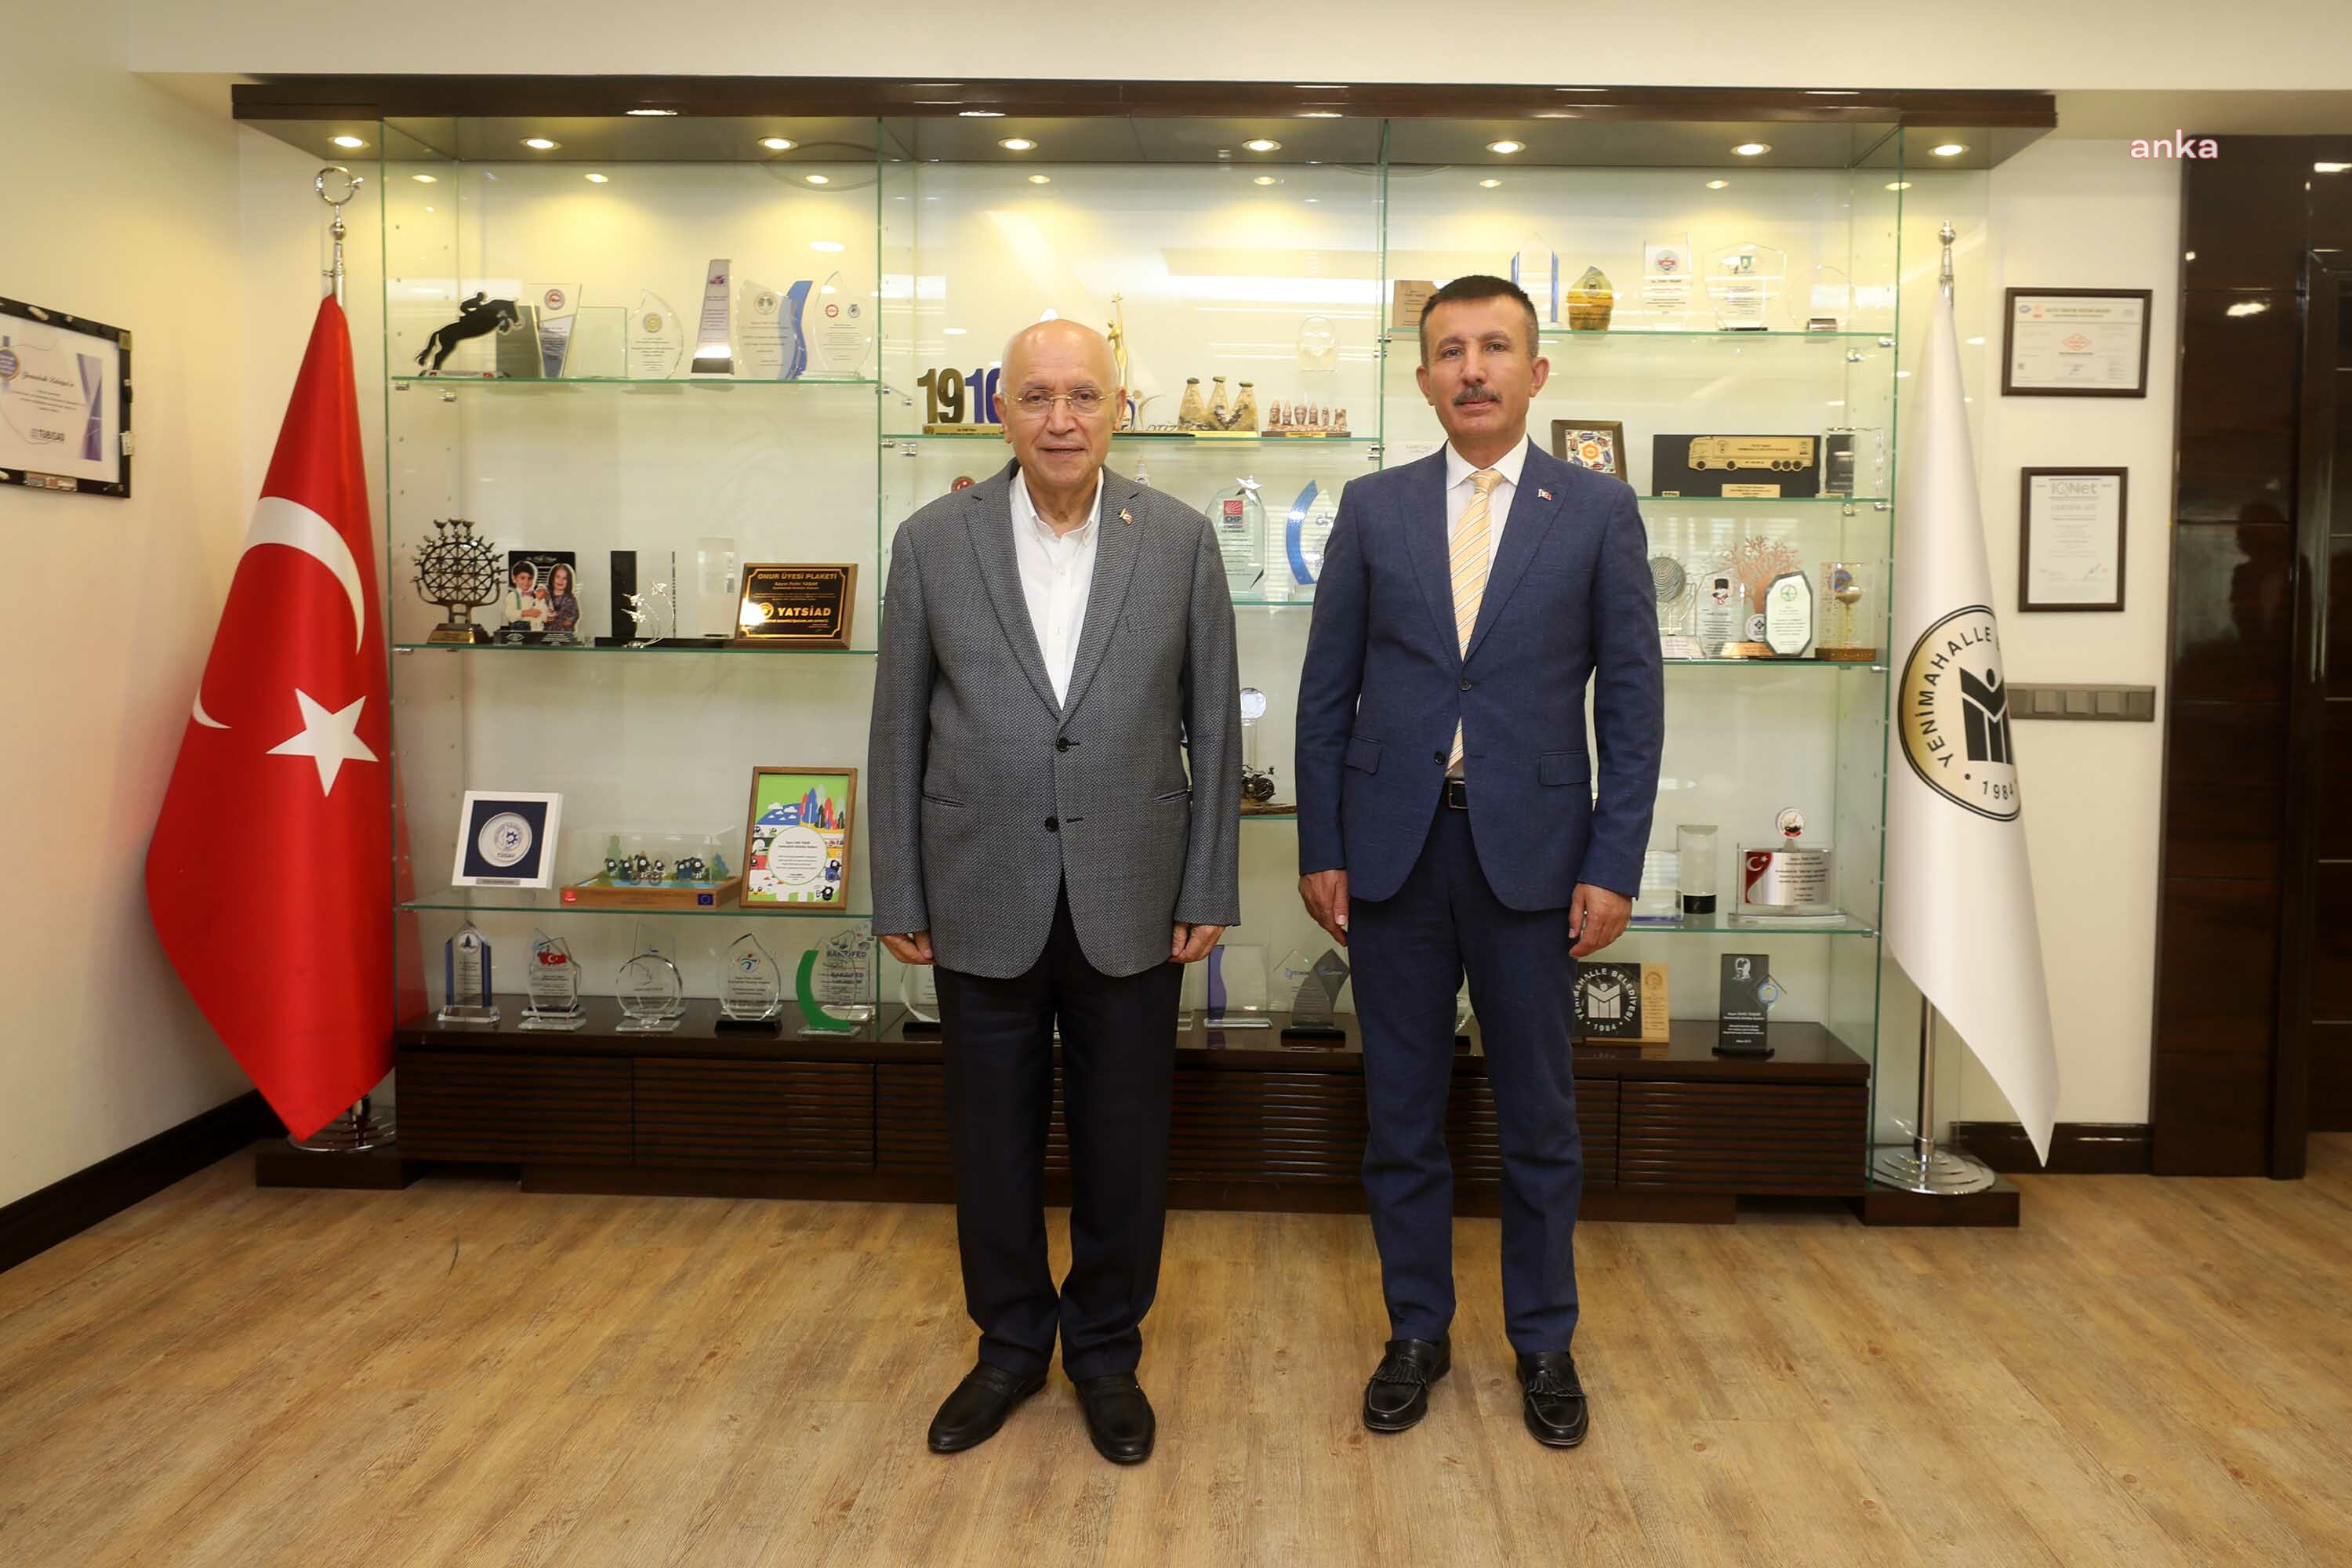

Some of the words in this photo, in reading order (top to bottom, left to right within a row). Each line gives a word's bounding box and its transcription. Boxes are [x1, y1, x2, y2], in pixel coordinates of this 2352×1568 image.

[2050, 481, 2098, 496] IQNet
[777, 605, 832, 617] YATSİAD
[1915, 626, 1992, 768] YENİMAHALLE
